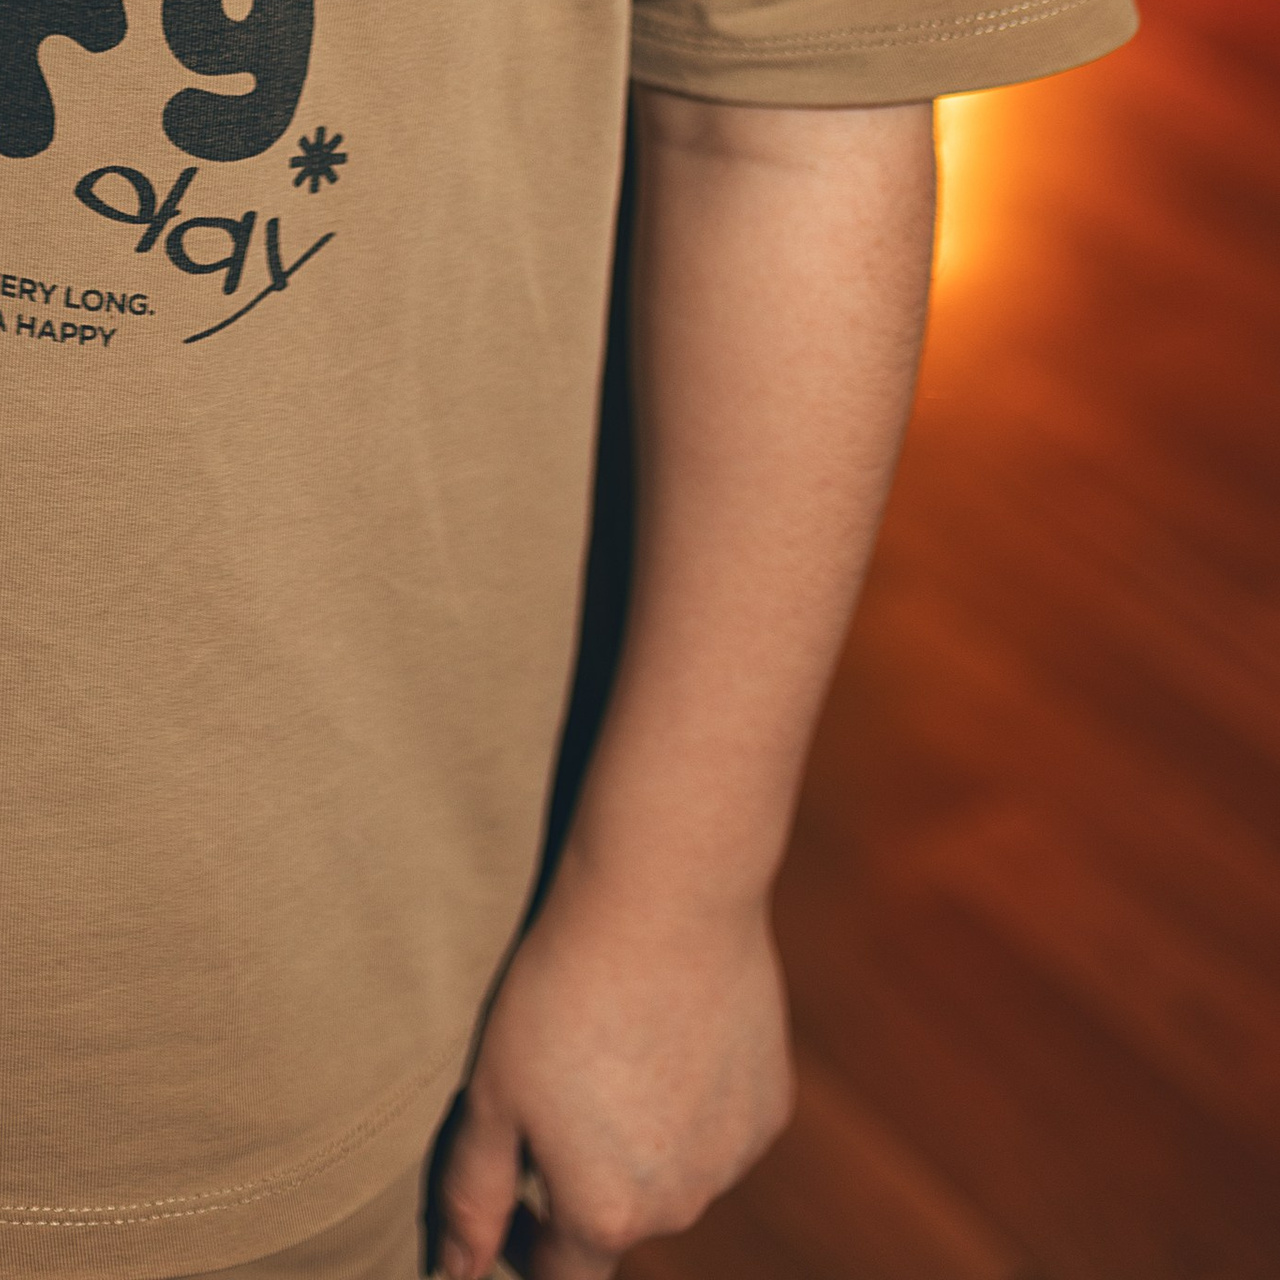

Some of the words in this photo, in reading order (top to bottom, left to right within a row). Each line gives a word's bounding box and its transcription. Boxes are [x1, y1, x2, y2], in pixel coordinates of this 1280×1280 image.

[73, 164, 337, 344] day
[64, 285, 156, 317] LONG.
[16, 313, 118, 348] HAPPY
